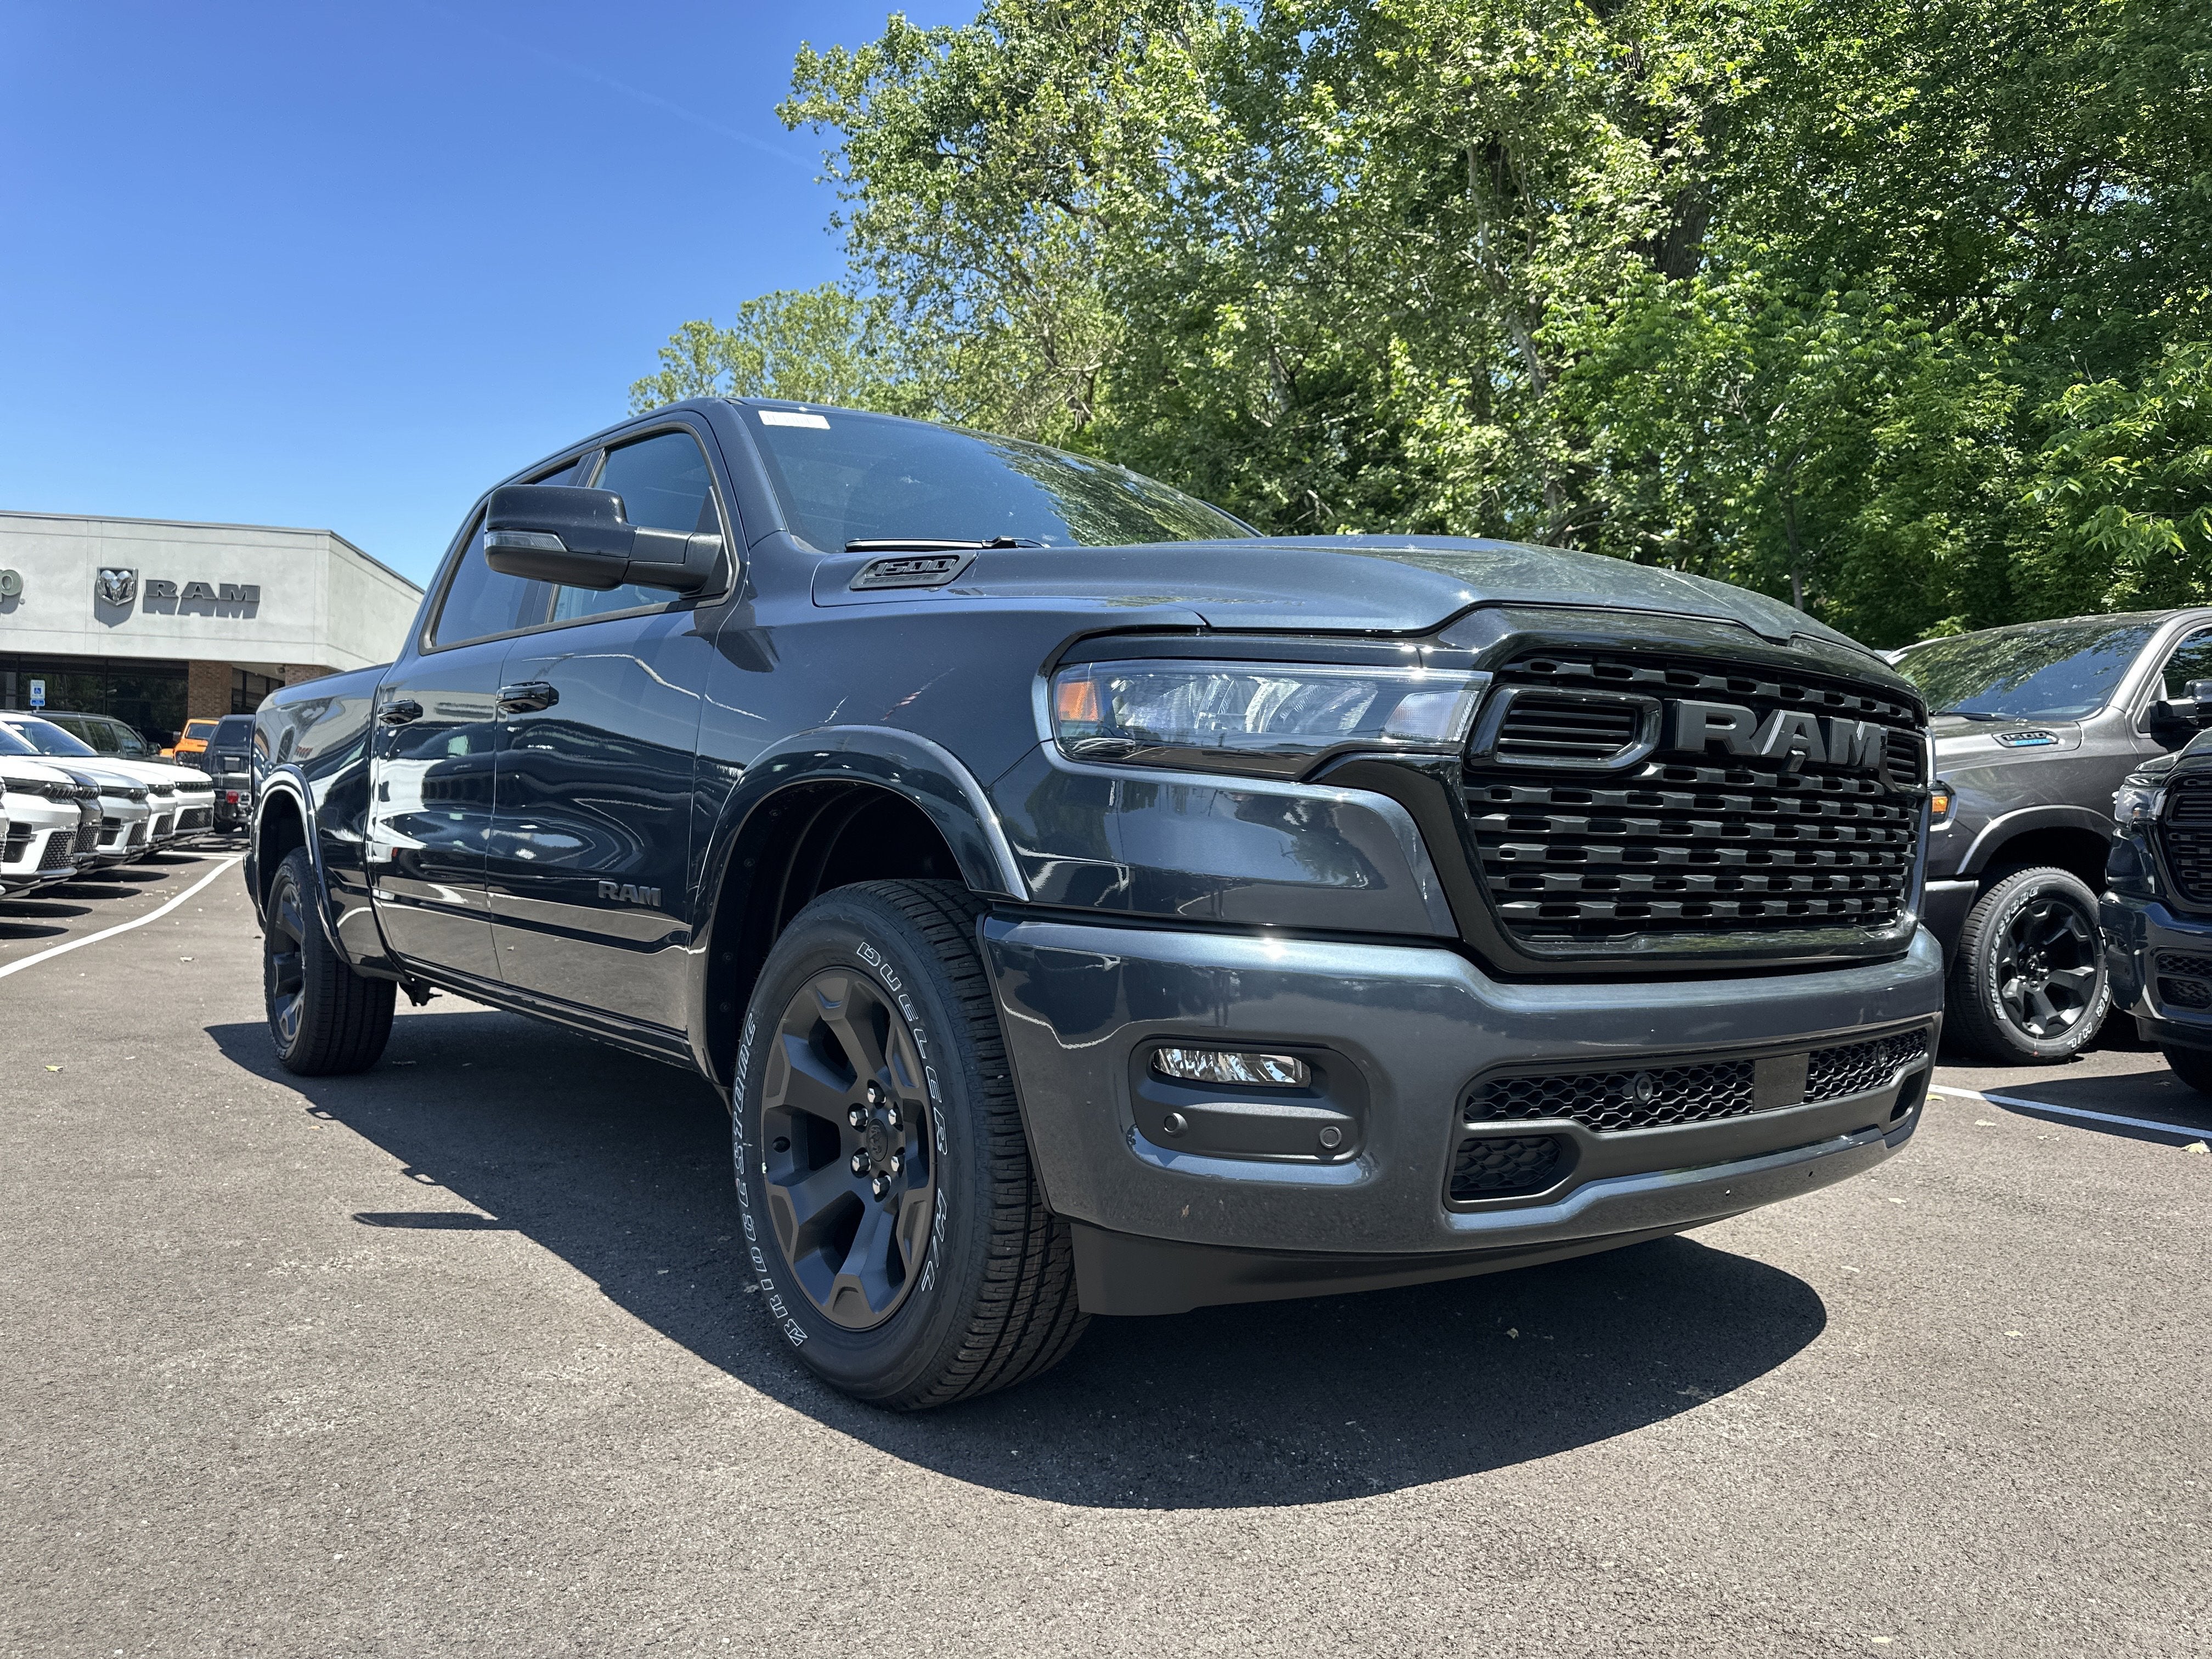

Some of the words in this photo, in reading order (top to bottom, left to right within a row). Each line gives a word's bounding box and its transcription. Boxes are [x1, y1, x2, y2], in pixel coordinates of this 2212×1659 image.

[874, 558, 956, 576] 1500
[145, 579, 261, 602] RAM
[1674, 698, 1887, 768] RAM
[2002, 732, 2047, 741] 1500
[598, 880, 662, 907] RAM
[2067, 1022, 2092, 1048] H/L
[856, 941, 948, 1155] DUELER
[921, 1188, 947, 1291] H/L
[733, 1012, 808, 1347] BRIDGESTONE
